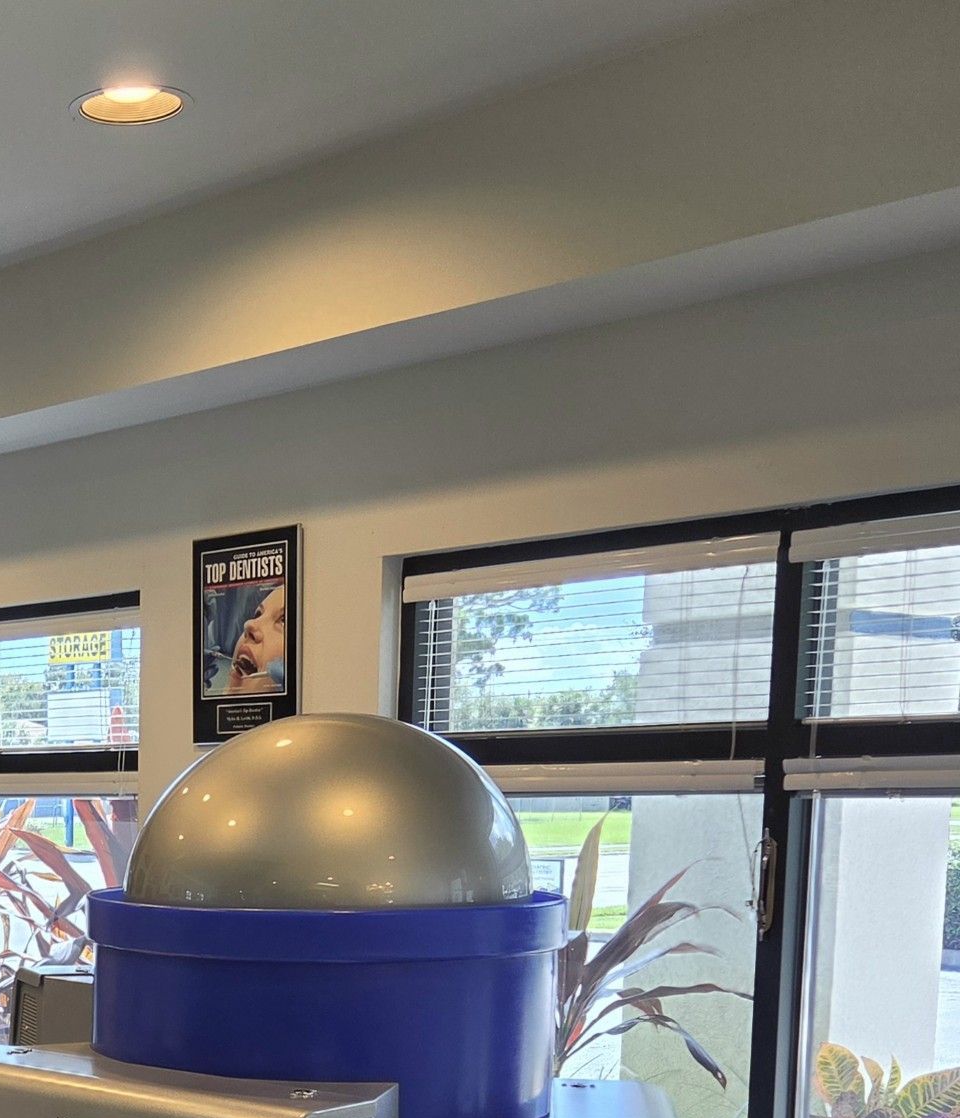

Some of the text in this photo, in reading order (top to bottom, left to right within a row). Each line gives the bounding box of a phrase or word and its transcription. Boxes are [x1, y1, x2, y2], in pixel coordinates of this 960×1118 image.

[205, 555, 283, 584] TOP DENTISTS
[49, 634, 107, 659] STORAGE
